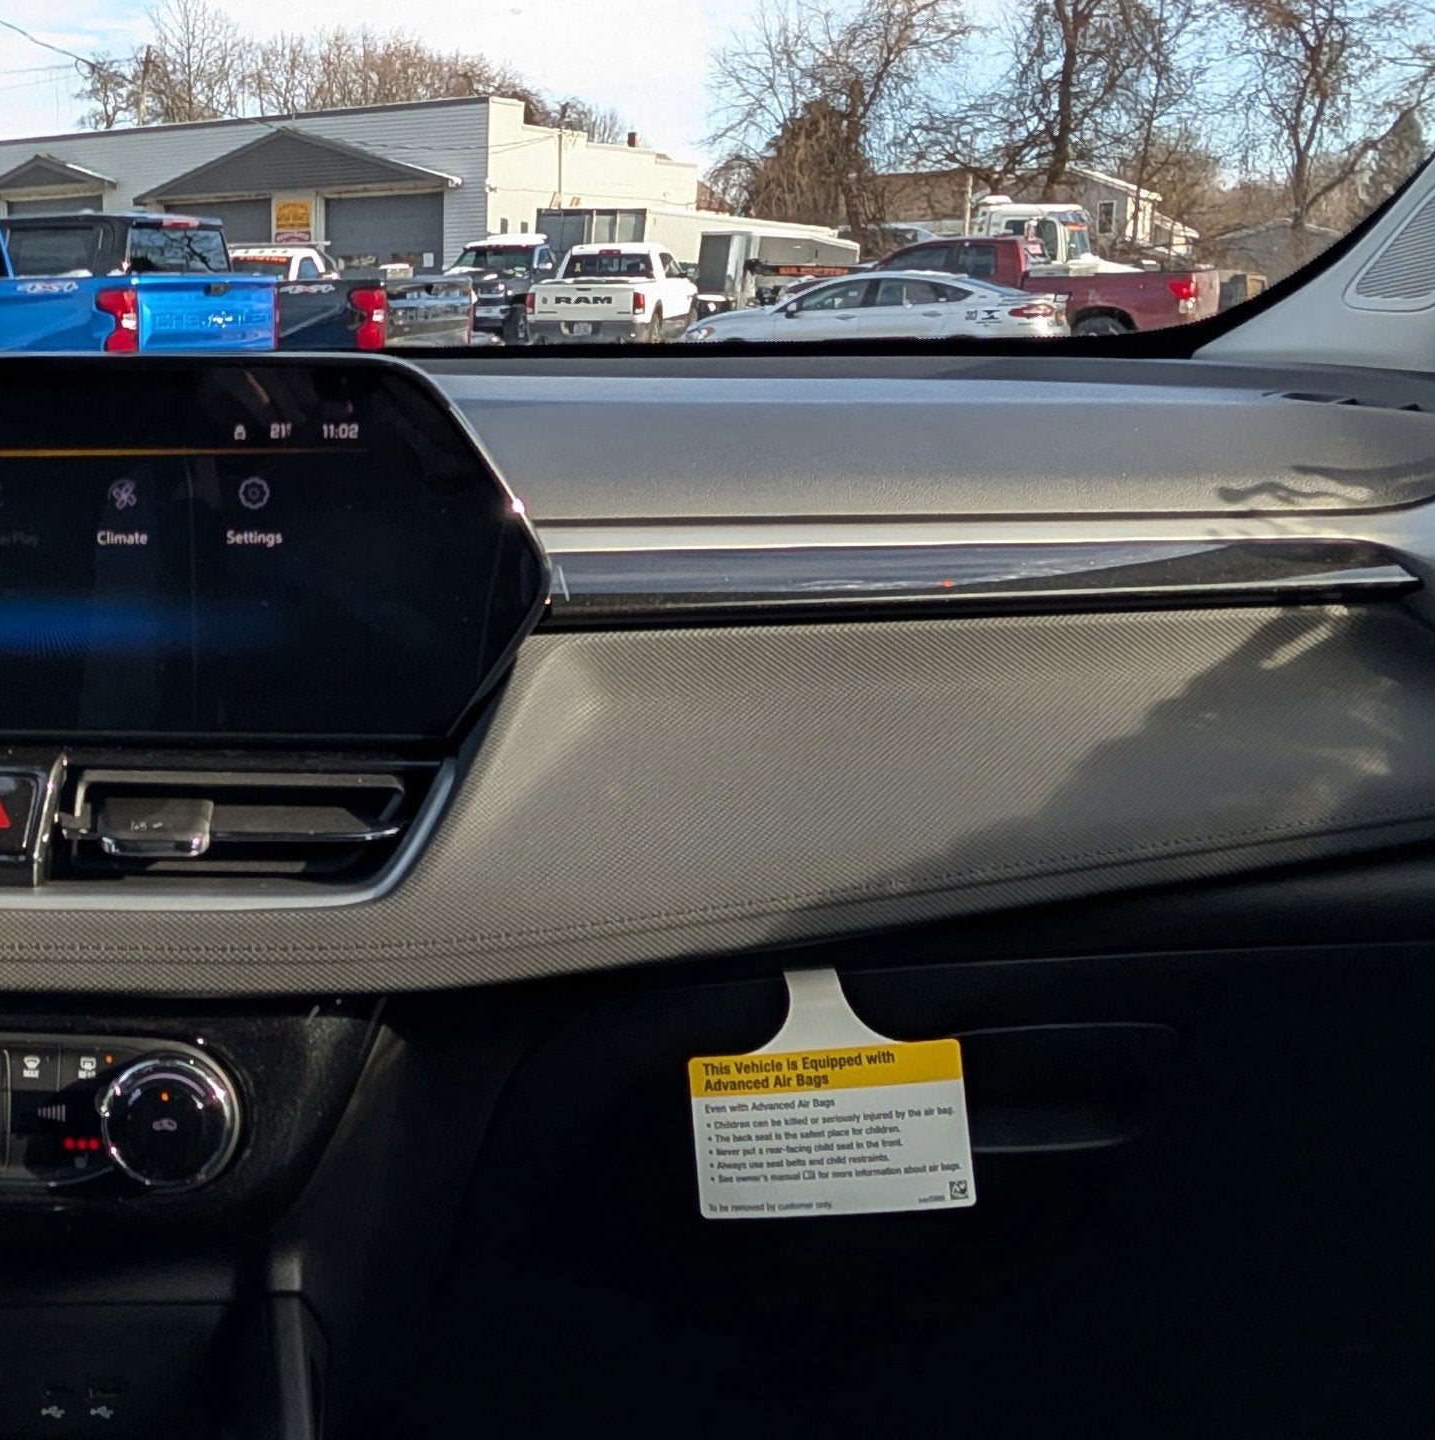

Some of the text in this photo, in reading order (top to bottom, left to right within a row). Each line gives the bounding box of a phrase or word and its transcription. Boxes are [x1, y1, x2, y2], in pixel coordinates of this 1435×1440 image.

[555, 296, 612, 304] RAM
[322, 423, 359, 439] 11:02
[97, 530, 148, 545] Climate
[226, 529, 283, 548] Settings
[703, 1051, 896, 1076] This Vehicle is Equipped with
[704, 1073, 829, 1092] Advanced Air Bags
[705, 1098, 835, 1114] Even with Advanced Air Bags
[714, 1106, 955, 1130] Children can be killed or seriously injured by the air bag.
[715, 1125, 901, 1143] The back seat is the safest place for children.
[716, 1148, 740, 1156] Never
[742, 1147, 756, 1157] put
[766, 1145, 812, 1154] rear-facing
[814, 1143, 834, 1152] child
[836, 1142, 854, 1151] seat
[855, 1141, 864, 1149] in
[866, 1140, 879, 1149] the
[881, 1138, 903, 1147] front.
[717, 1161, 747, 1171] Always
[766, 1160, 784, 1168] seat
[786, 1158, 806, 1167] belts
[808, 1158, 824, 1166] and
[826, 1156, 846, 1165] child
[849, 1154, 890, 1164] restraints.
[718, 1162, 961, 1183] See owner's manual for more information about air bags.
[731, 1202, 764, 1211] removed
[778, 1202, 813, 1211] customer
